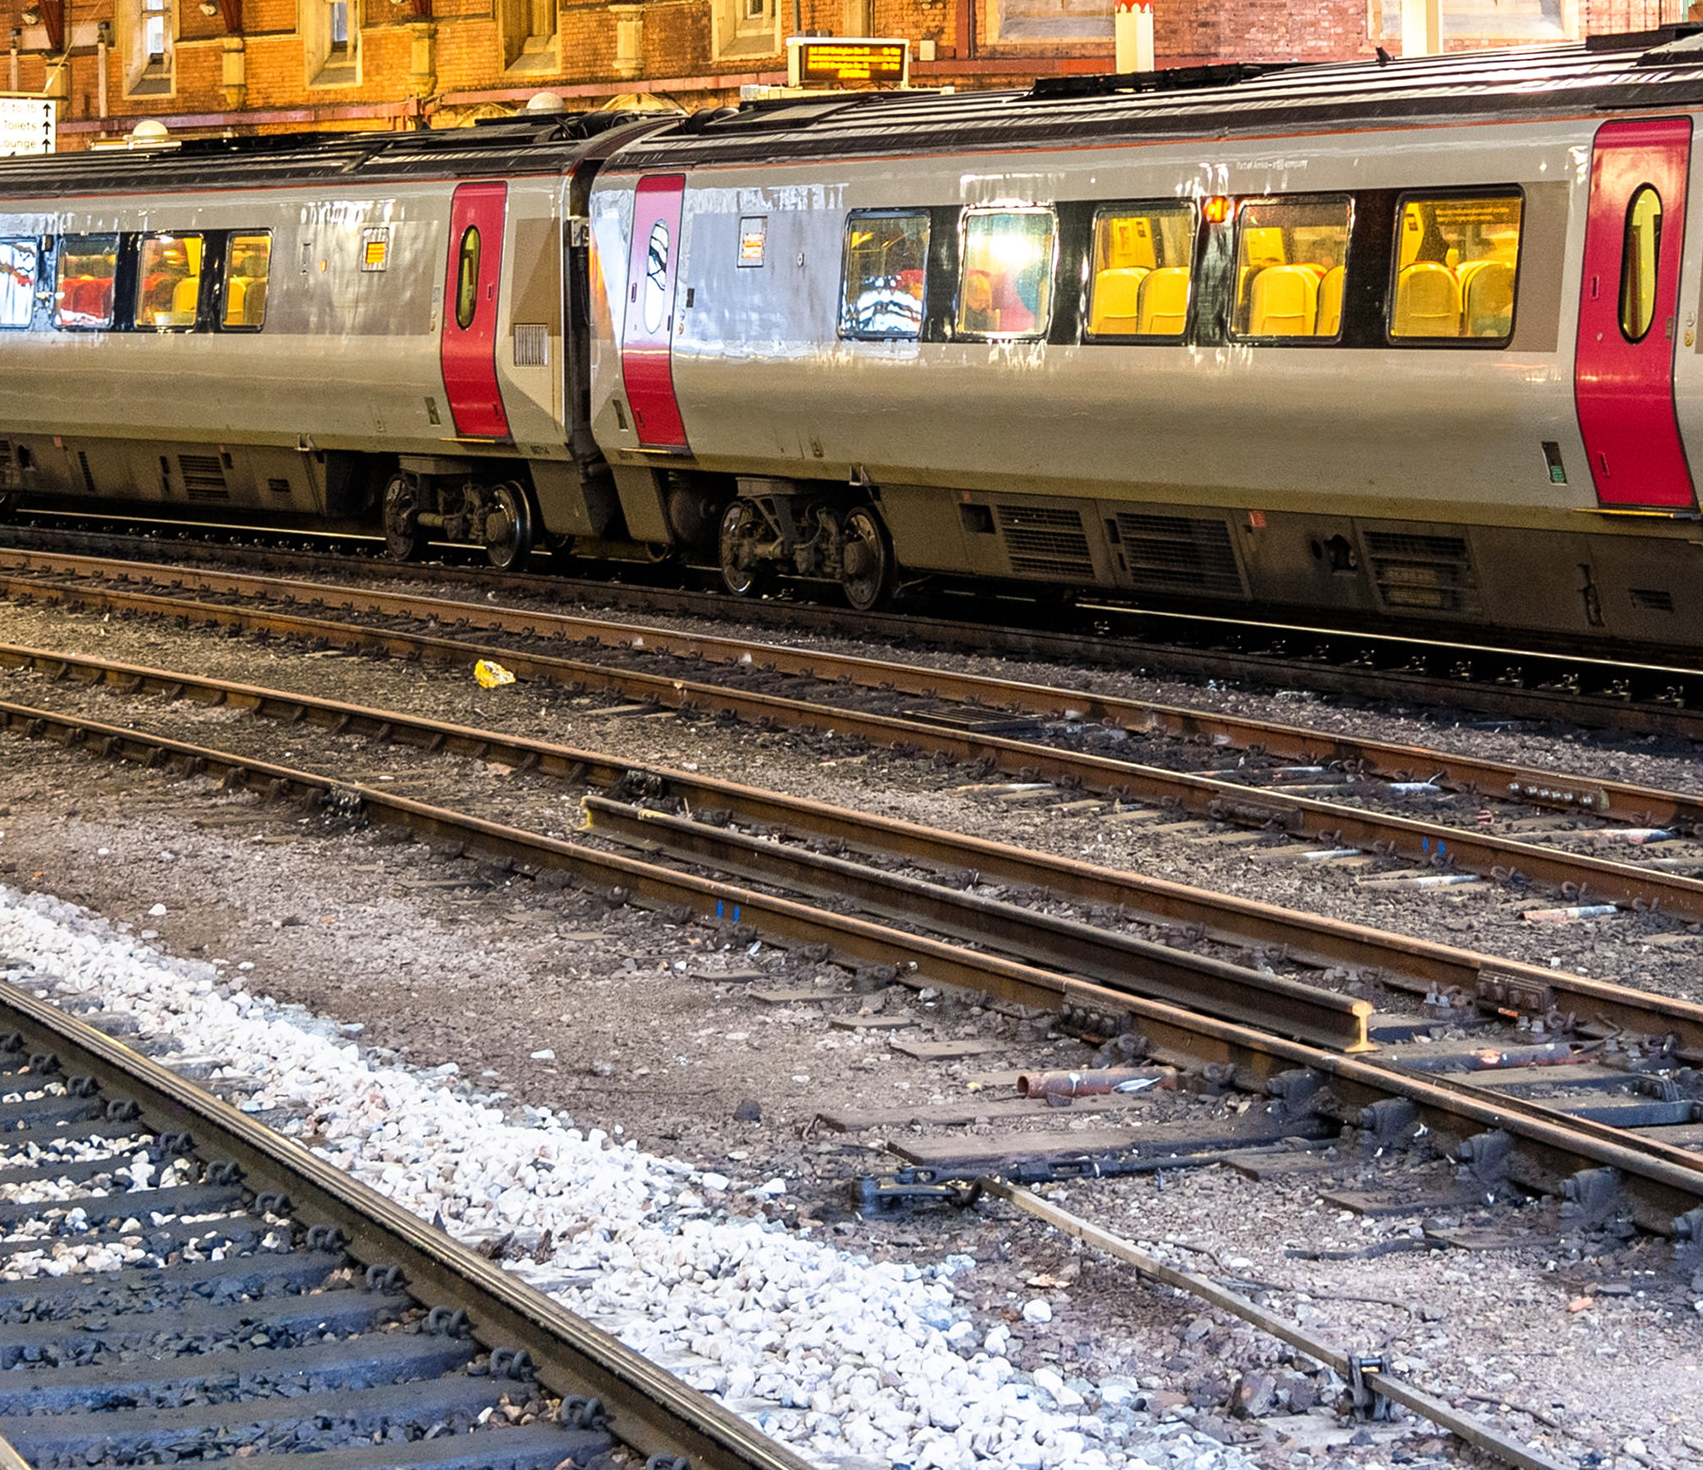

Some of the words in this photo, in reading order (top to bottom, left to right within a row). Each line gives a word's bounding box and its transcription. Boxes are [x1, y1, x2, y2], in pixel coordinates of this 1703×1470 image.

[1, 102, 6, 111] 5
[12, 103, 22, 113] to
[27, 103, 37, 113] 15
[3, 120, 37, 130] Toilets
